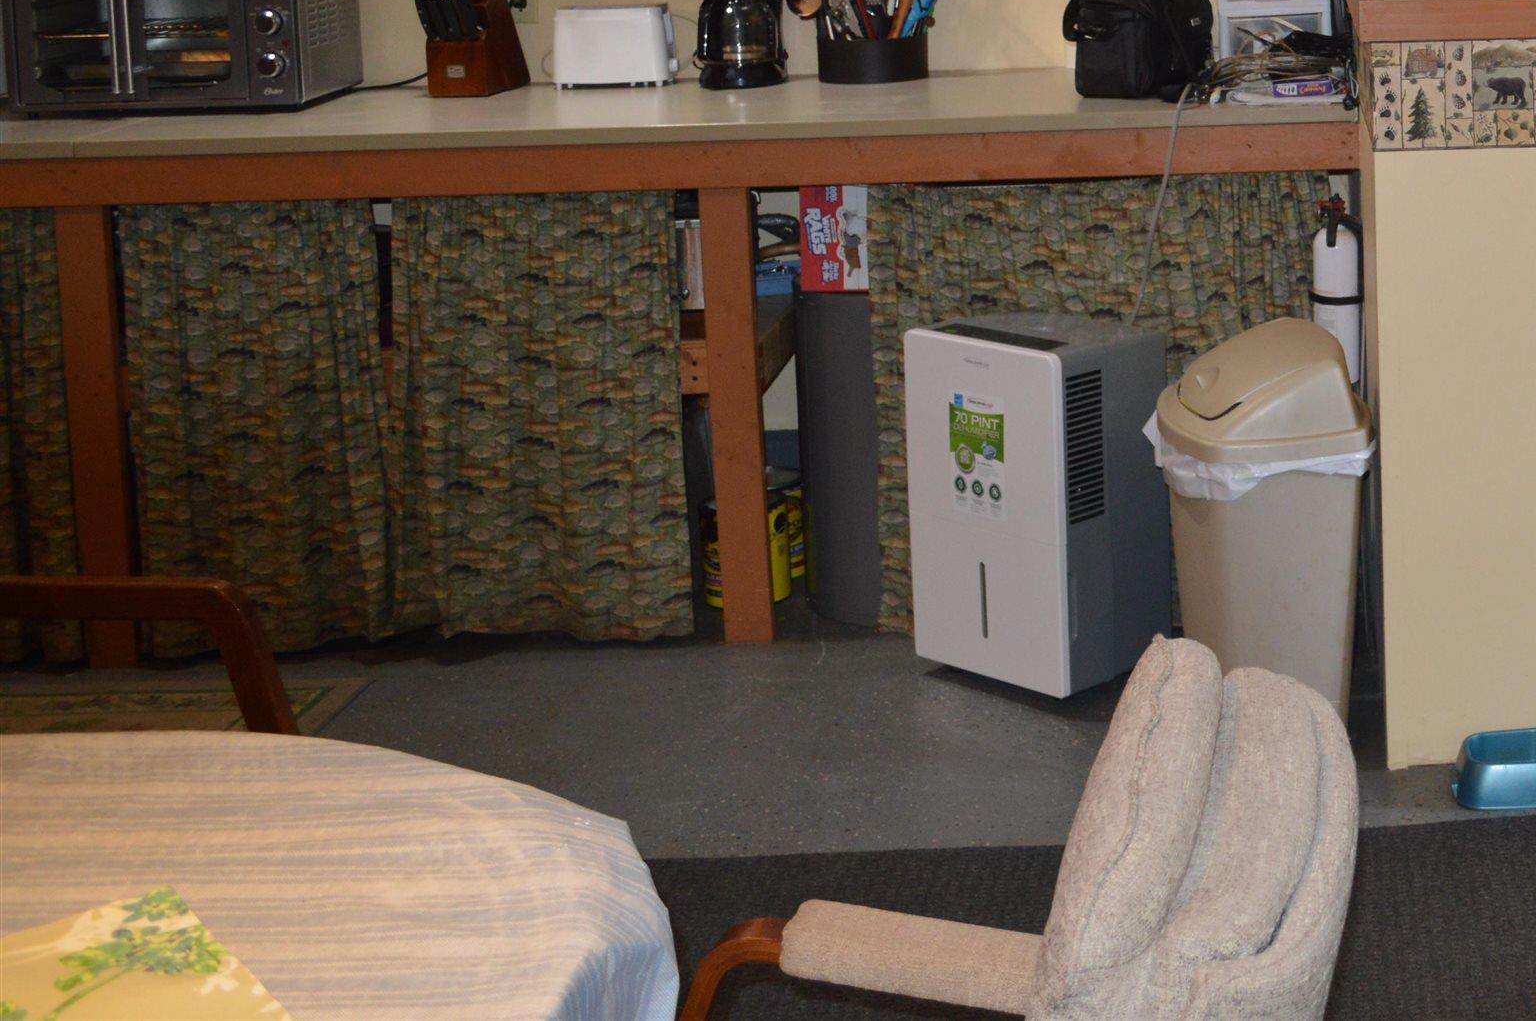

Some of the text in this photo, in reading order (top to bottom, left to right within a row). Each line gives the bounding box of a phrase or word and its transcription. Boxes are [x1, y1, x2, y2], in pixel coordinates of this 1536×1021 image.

[804, 208, 827, 255] RAGS
[953, 411, 1001, 431] 70 PINT
